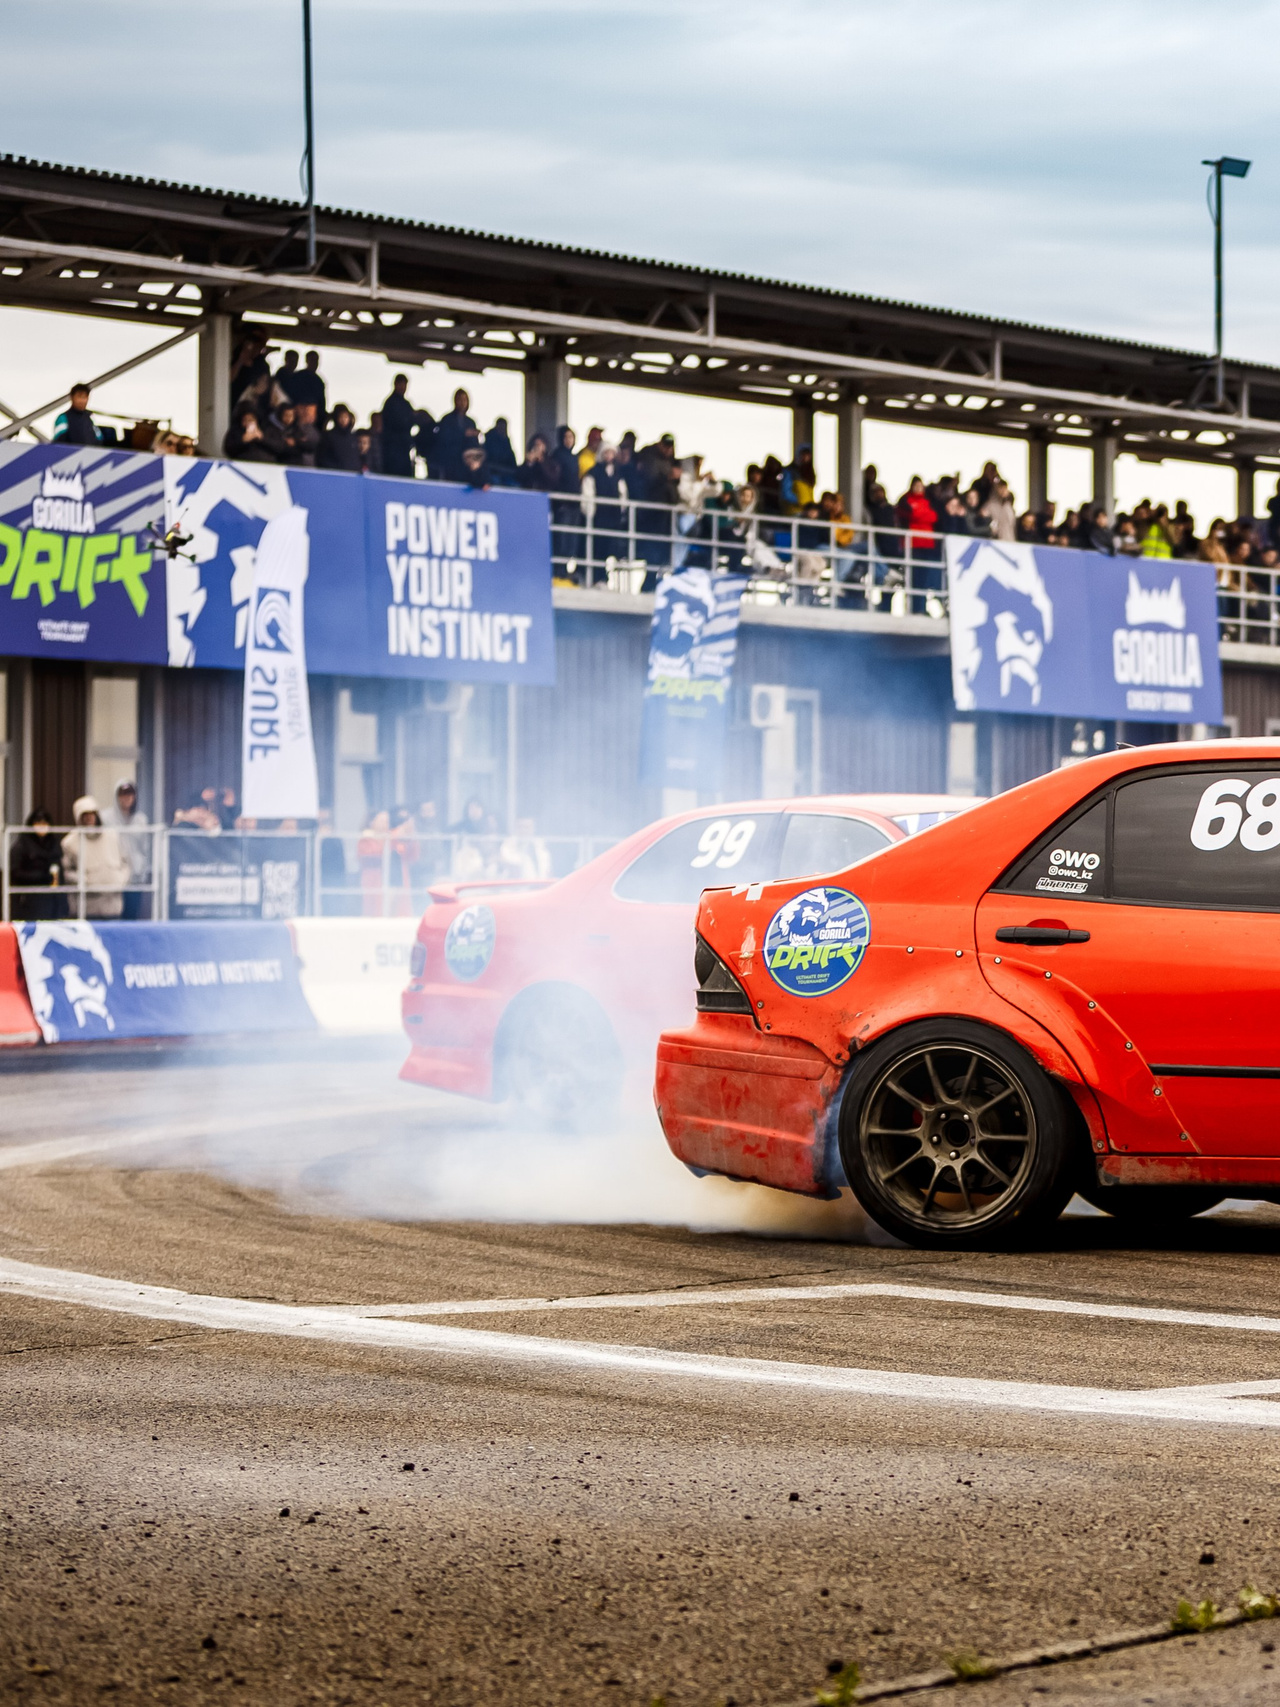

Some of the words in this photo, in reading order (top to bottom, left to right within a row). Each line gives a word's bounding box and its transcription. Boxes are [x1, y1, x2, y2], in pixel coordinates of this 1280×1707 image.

[33, 496, 96, 533] GORILLA
[385, 501, 499, 562] POWER
[386, 553, 472, 609] YOUR
[387, 604, 532, 664] INSTINCT
[1113, 628, 1203, 688] GORILLA
[690, 820, 757, 868] 99
[770, 942, 858, 970] DRIFT
[819, 928, 851, 940] GORILLA
[123, 964, 178, 989] POWER
[178, 961, 218, 986] YOUR
[219, 959, 283, 984] INSTINCT
